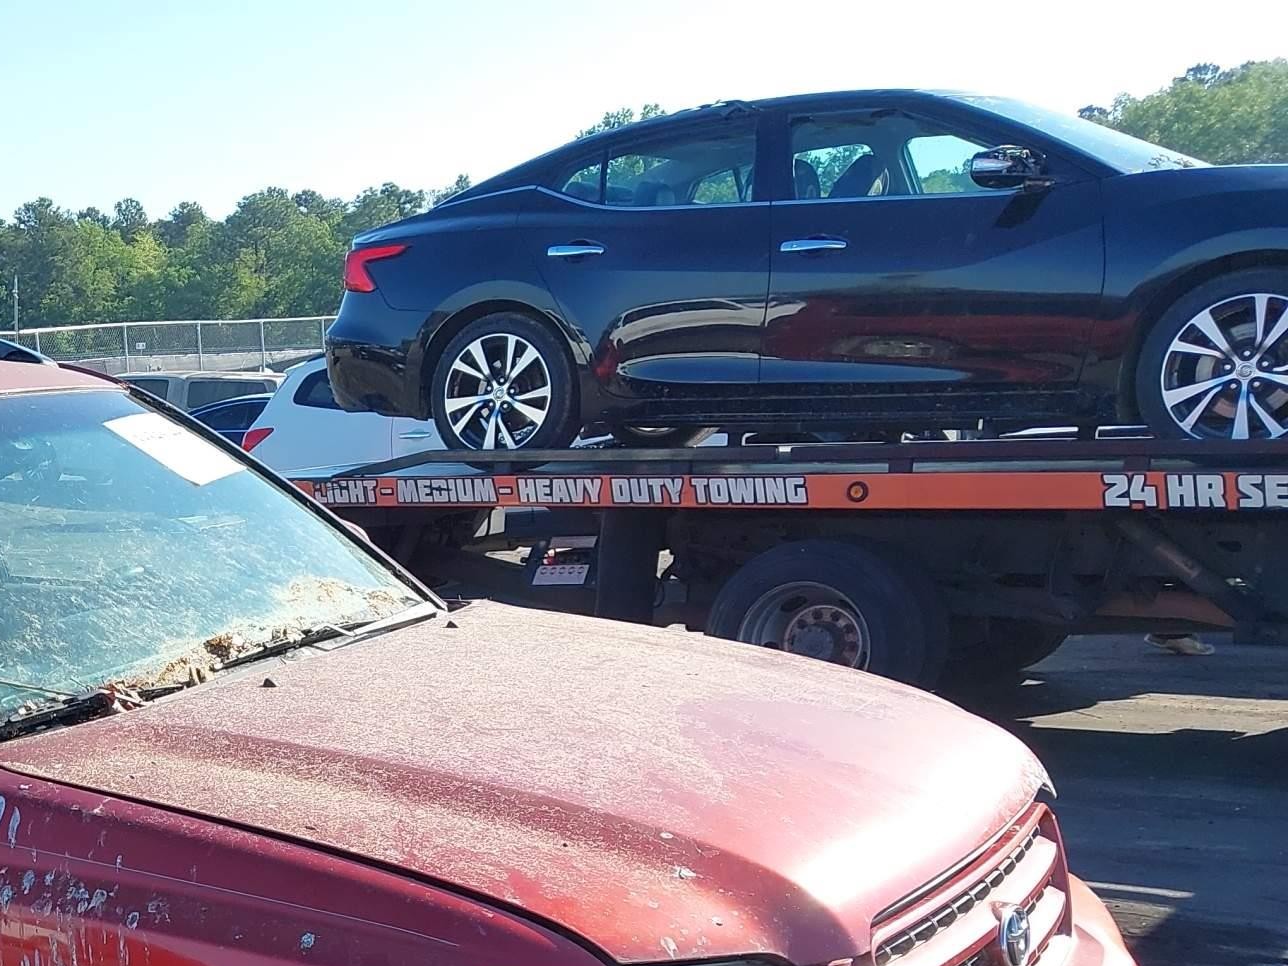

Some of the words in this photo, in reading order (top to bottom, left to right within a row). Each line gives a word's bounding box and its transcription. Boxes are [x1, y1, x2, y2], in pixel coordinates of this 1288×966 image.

[396, 477, 498, 504] MEDIUM
[516, 477, 602, 504] HEAVY
[611, 477, 683, 504] DUTY
[691, 477, 808, 504] TOWING
[1102, 474, 1157, 508] 24
[1165, 474, 1227, 508] HR
